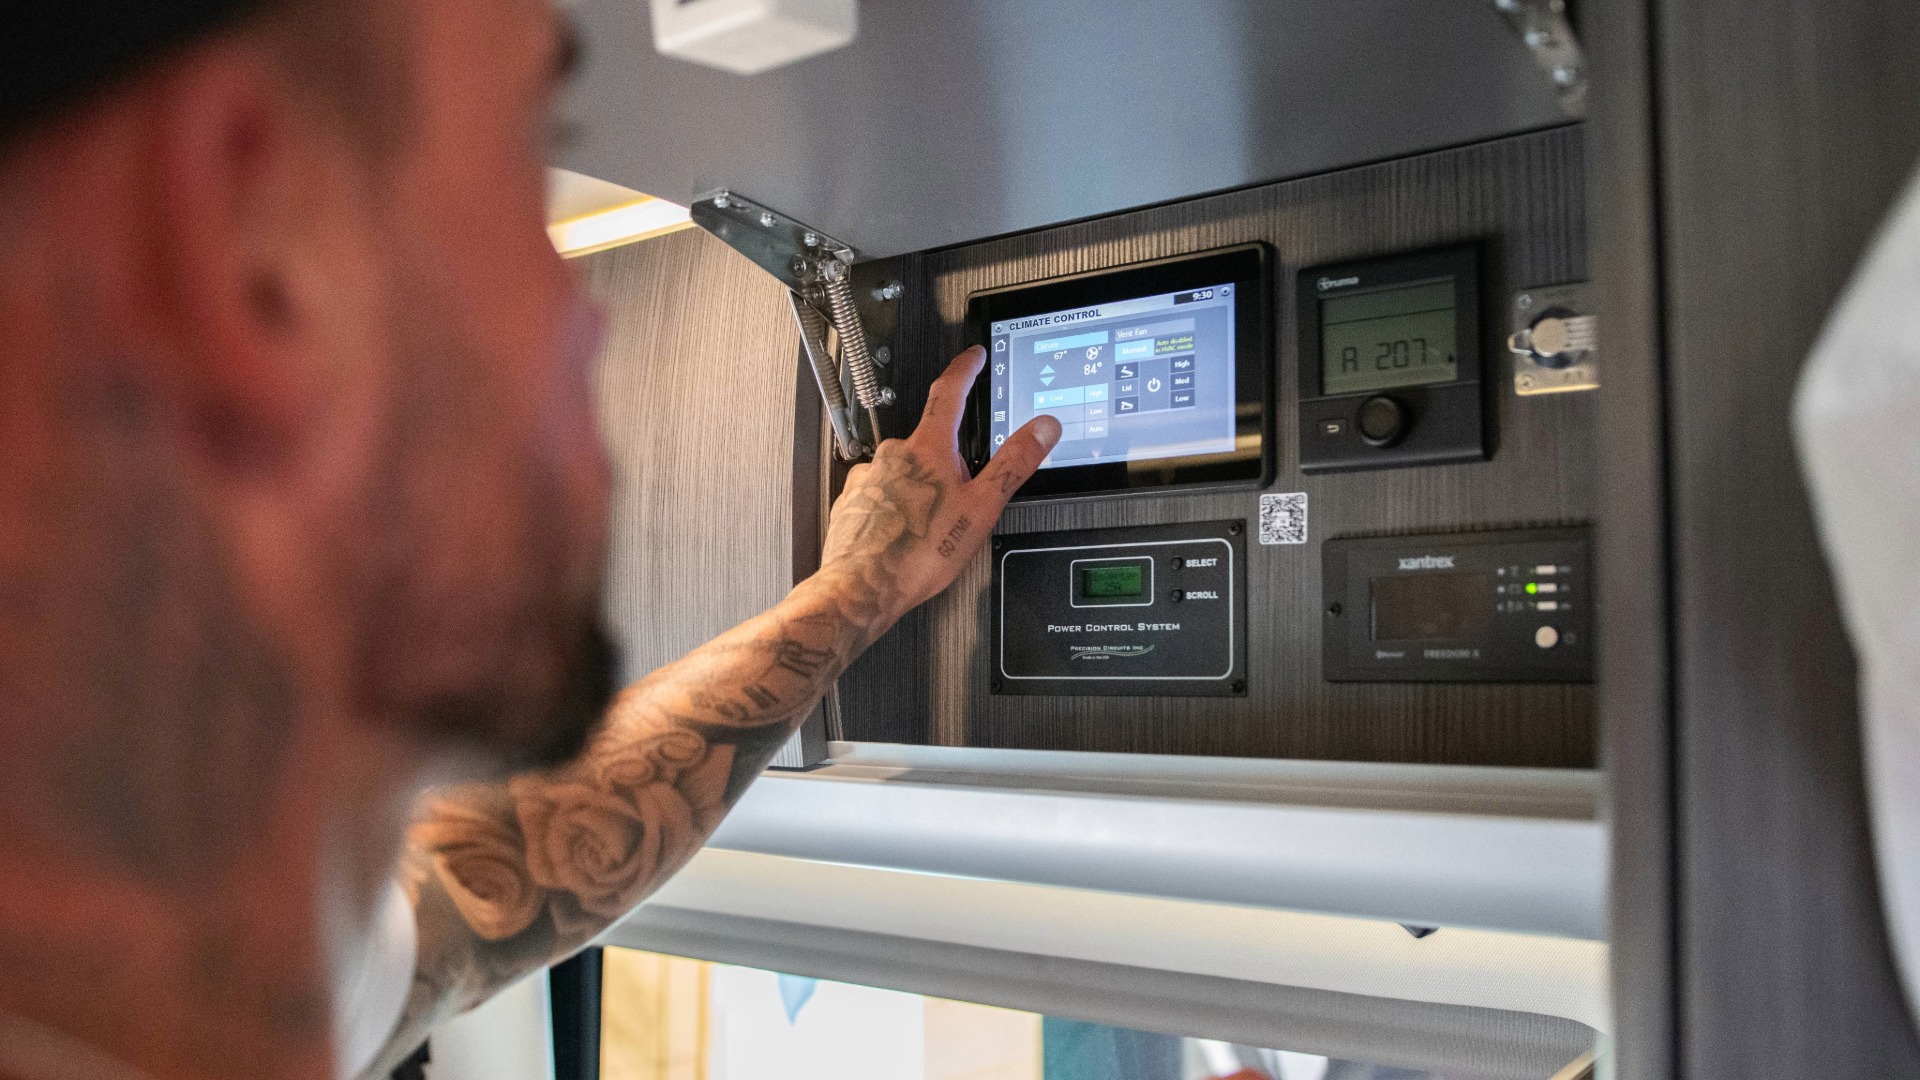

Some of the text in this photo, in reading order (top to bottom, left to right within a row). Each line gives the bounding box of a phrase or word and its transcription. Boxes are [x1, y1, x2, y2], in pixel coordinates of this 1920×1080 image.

[1192, 290, 1213, 301] 9:30
[1009, 309, 1102, 331] CLIMATE CONTROL
[1117, 328, 1148, 338] Vent Fan
[1170, 336, 1193, 344] disabled
[1036, 341, 1060, 350] Climate
[1342, 338, 1427, 373] A 207
[1083, 361, 1103, 376] 84°
[1174, 360, 1191, 369] High
[1174, 376, 1190, 385] Med
[1121, 384, 1132, 392] Lid
[1174, 395, 1190, 403] Low
[1185, 558, 1218, 568] SELECT
[1185, 591, 1219, 600] SCROLL
